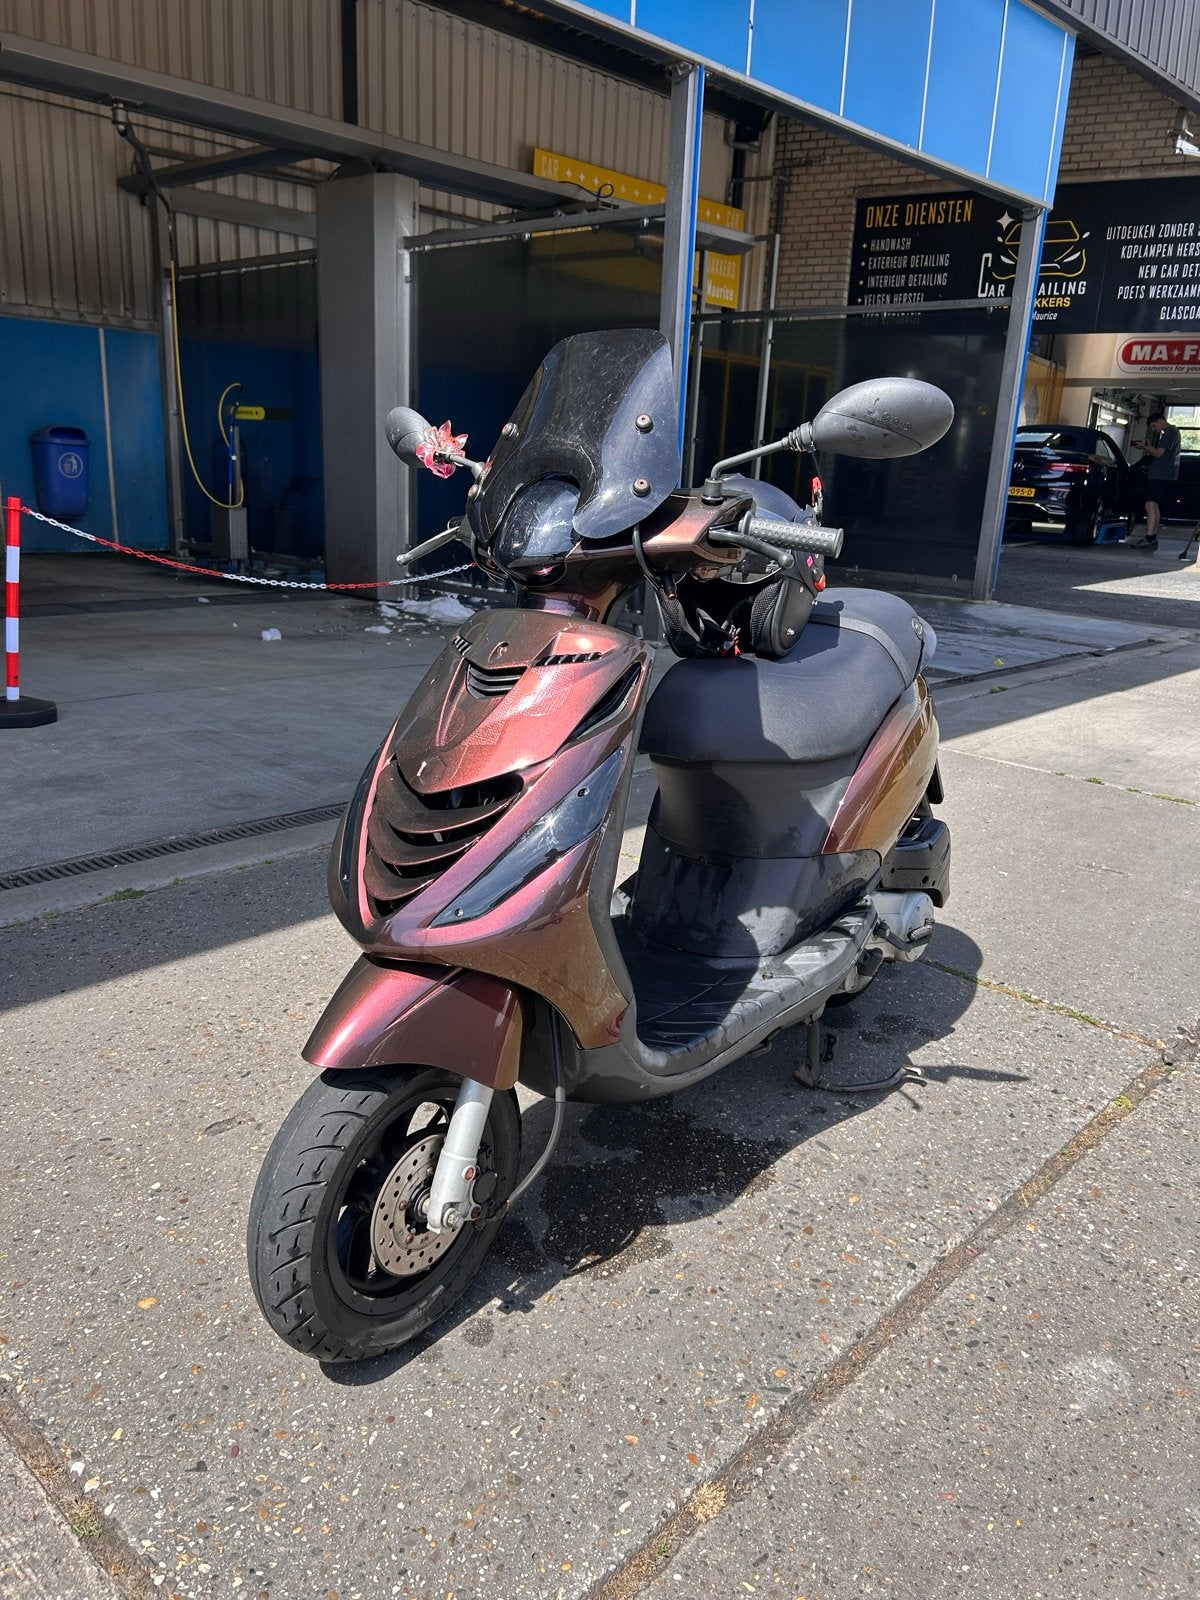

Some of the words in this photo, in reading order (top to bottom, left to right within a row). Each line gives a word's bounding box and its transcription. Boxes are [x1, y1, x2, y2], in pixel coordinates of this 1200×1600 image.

[541, 156, 559, 179] CAR
[866, 204, 899, 228] ONZE
[905, 200, 973, 225] DIENSTEN
[1106, 224, 1156, 240] UITDEUKEN
[1158, 222, 1195, 238] ZONDER
[870, 237, 912, 252] HANDWASH
[1120, 243, 1174, 259] KOPLAMPEN
[868, 256, 908, 270] EXTERIEUR
[910, 253, 950, 268] DETAILING
[977, 253, 1006, 297] CAR
[1138, 264, 1158, 279] NEW
[1160, 264, 1179, 279] CAR
[867, 274, 906, 289] INTERIEUR
[908, 273, 948, 287] DETAILING
[1117, 285, 1146, 300] POETS
[1140, 364, 1173, 372] cosmetics
[1174, 364, 1186, 372] for
